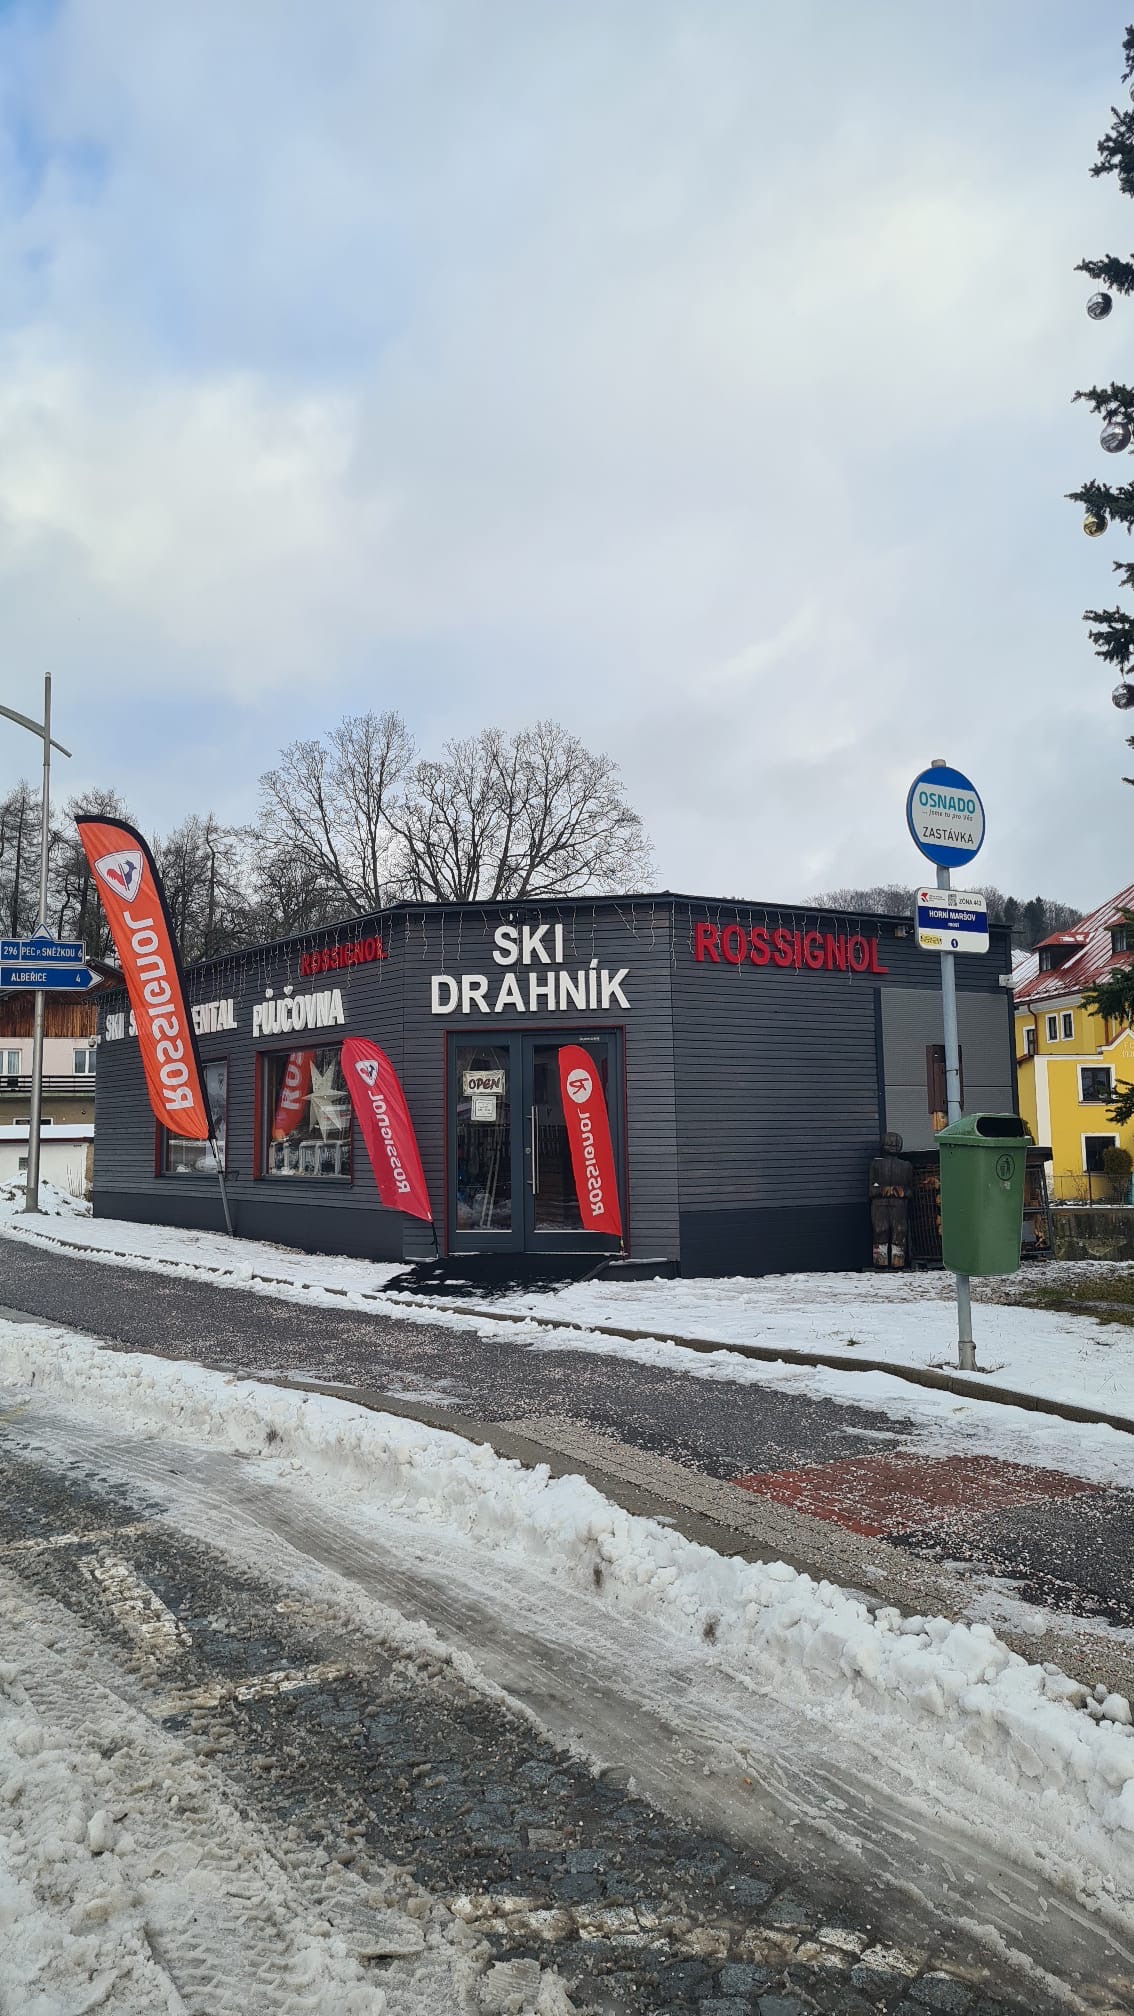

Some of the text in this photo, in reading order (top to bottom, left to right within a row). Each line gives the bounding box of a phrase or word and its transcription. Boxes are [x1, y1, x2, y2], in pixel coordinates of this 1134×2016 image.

[919, 791, 976, 814] OSNADO
[922, 826, 974, 845] ZASTÁVKA
[929, 909, 976, 922] HORNÍ MARŠOV
[3, 946, 18, 955] 296
[21, 946, 36, 956] PEC
[41, 945, 75, 957] SNĚŽKOU
[77, 949, 82, 957] 6
[300, 936, 388, 977] ROSSIGNOL
[492, 922, 564, 967] SKI
[694, 921, 890, 975] ROSSIGNOL
[11, 971, 81, 983] ALBEŘICE 4
[430, 957, 632, 1014] DRAHNÍK
[191, 998, 238, 1035] ENTAL
[252, 985, 346, 1038] PŮJČOVNA
[468, 1077, 501, 1091] OPEN
